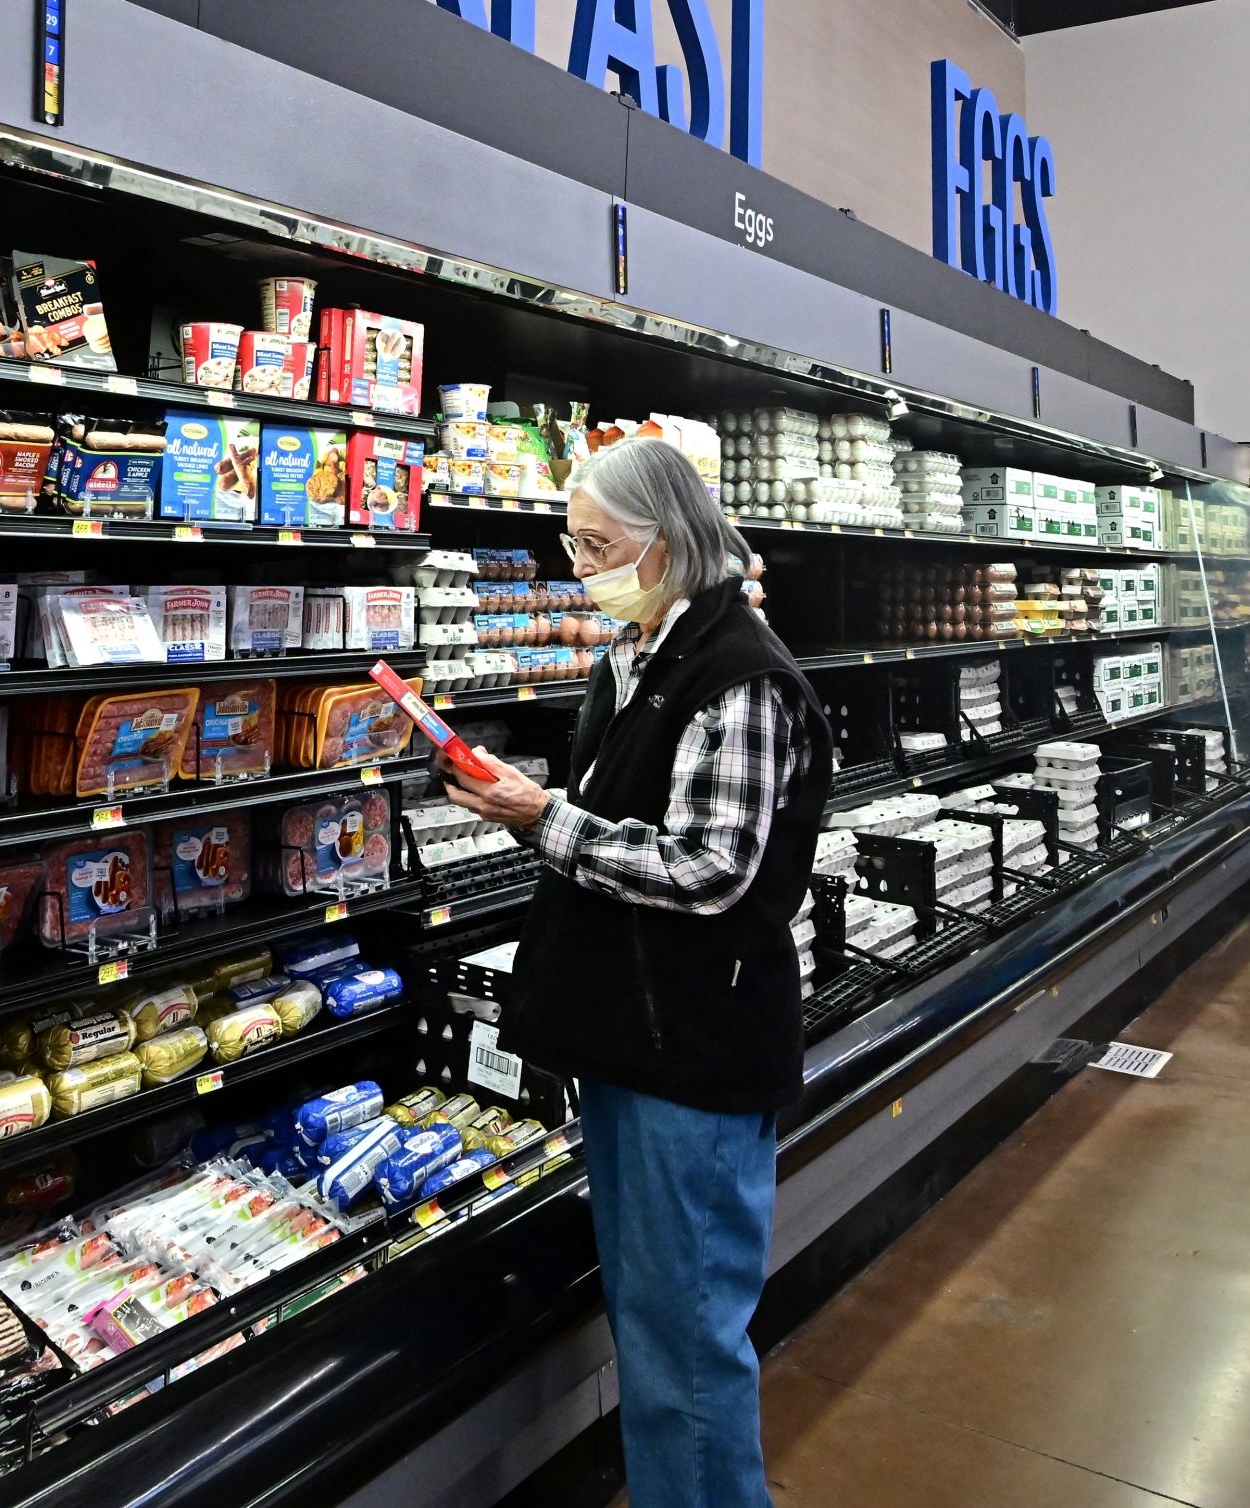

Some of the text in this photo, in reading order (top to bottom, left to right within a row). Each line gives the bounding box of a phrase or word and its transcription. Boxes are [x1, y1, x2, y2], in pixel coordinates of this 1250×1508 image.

[46, 14, 58, 26] 29
[48, 45, 55, 56] 7
[930, 59, 1056, 317] EGGS
[735, 191, 774, 248] Eggs
[35, 291, 85, 316] BREAKFAST
[47, 303, 83, 323] COMBOS
[167, 440, 219, 458] all natural
[265, 451, 311, 469] all natural
[4, 591, 10, 599] 8
[166, 598, 209, 610] FARMER JOHN
[101, 967, 115, 982] 297
[81, 1024, 117, 1040] Regular
